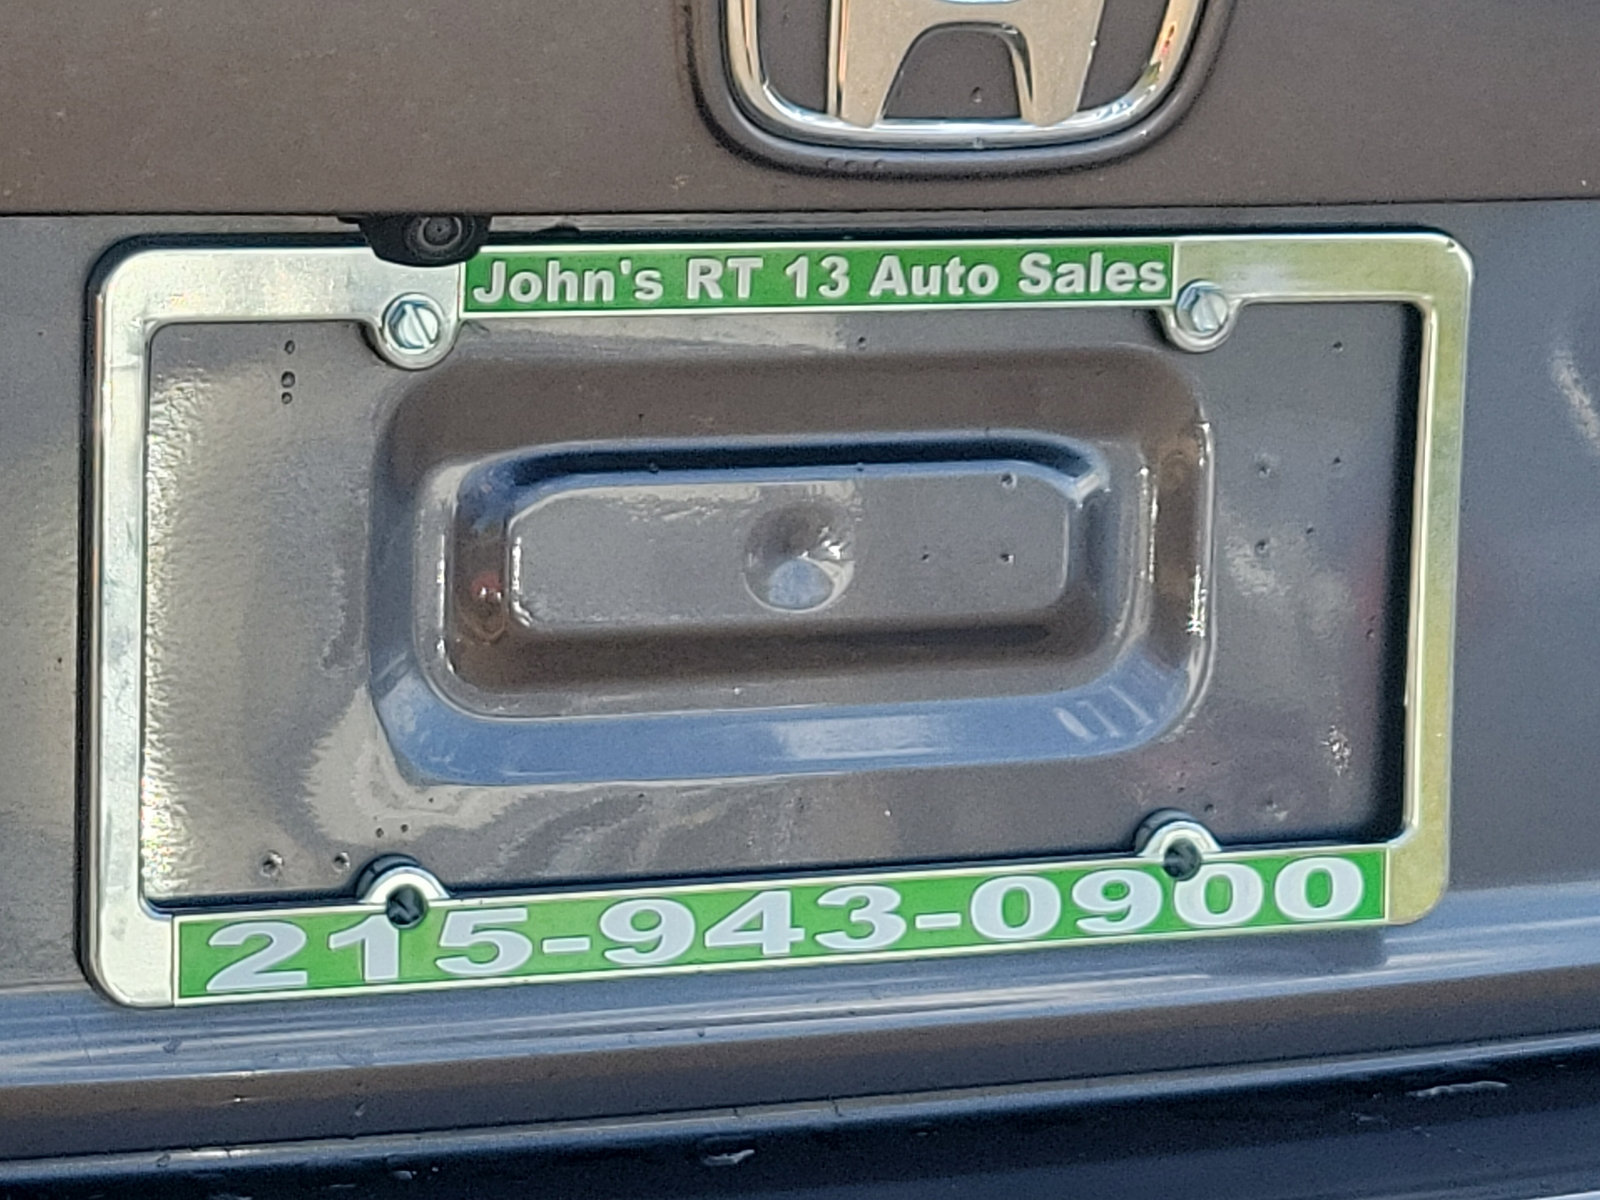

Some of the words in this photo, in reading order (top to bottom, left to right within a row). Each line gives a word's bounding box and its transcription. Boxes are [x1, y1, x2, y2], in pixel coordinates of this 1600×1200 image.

[473, 260, 662, 302] John's
[687, 257, 763, 299] RT
[785, 256, 849, 297] 13
[869, 255, 998, 296] Auto
[1018, 252, 1166, 294] Sales
[206, 857, 1364, 992] 215-943-0900
